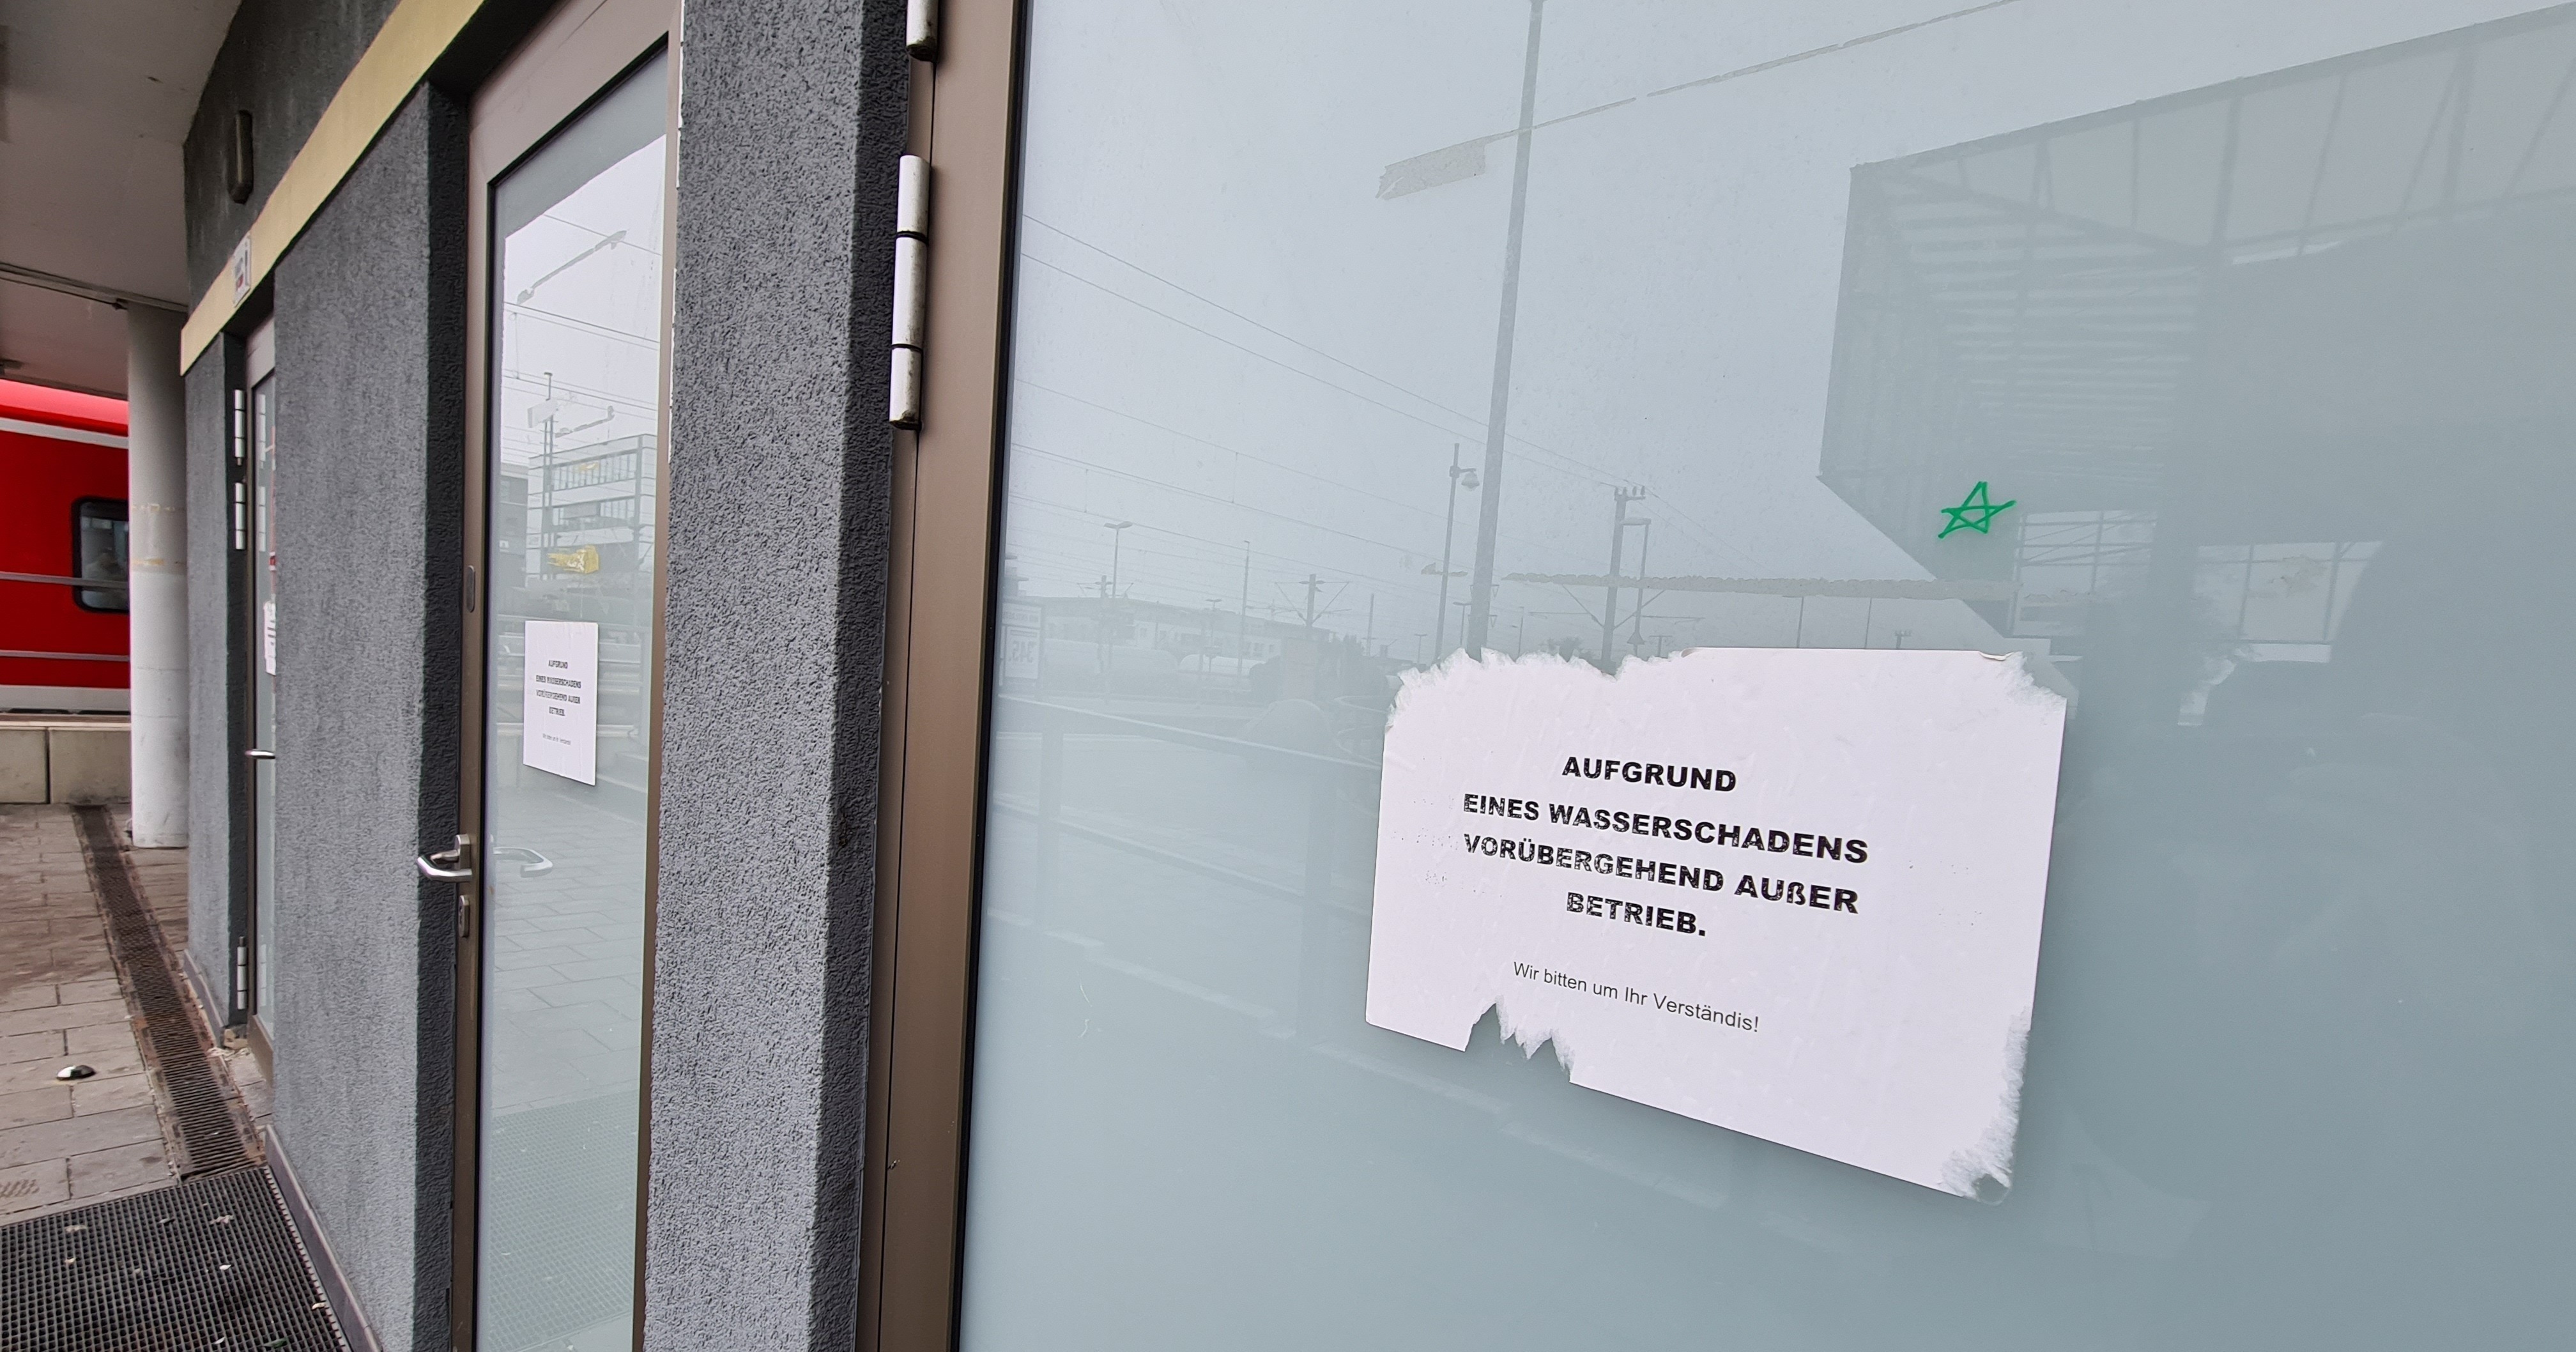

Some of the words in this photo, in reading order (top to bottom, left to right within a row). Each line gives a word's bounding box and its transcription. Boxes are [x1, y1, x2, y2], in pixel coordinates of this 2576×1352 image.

[1561, 757, 1736, 792] AUFGRUND
[1463, 794, 1539, 821] EINES
[1549, 803, 1868, 864] WASSERSCHADENS
[1463, 833, 1724, 891] VORÜBERGEHEND
[1734, 875, 1859, 914] AUßER
[1567, 892, 1706, 937] BETRIEB.
[1514, 962, 1540, 981] Wir
[1544, 969, 1586, 992] bitten
[1593, 983, 1618, 999] um
[1625, 987, 1648, 1006] Ihr
[1653, 992, 1759, 1033] Verständis!
